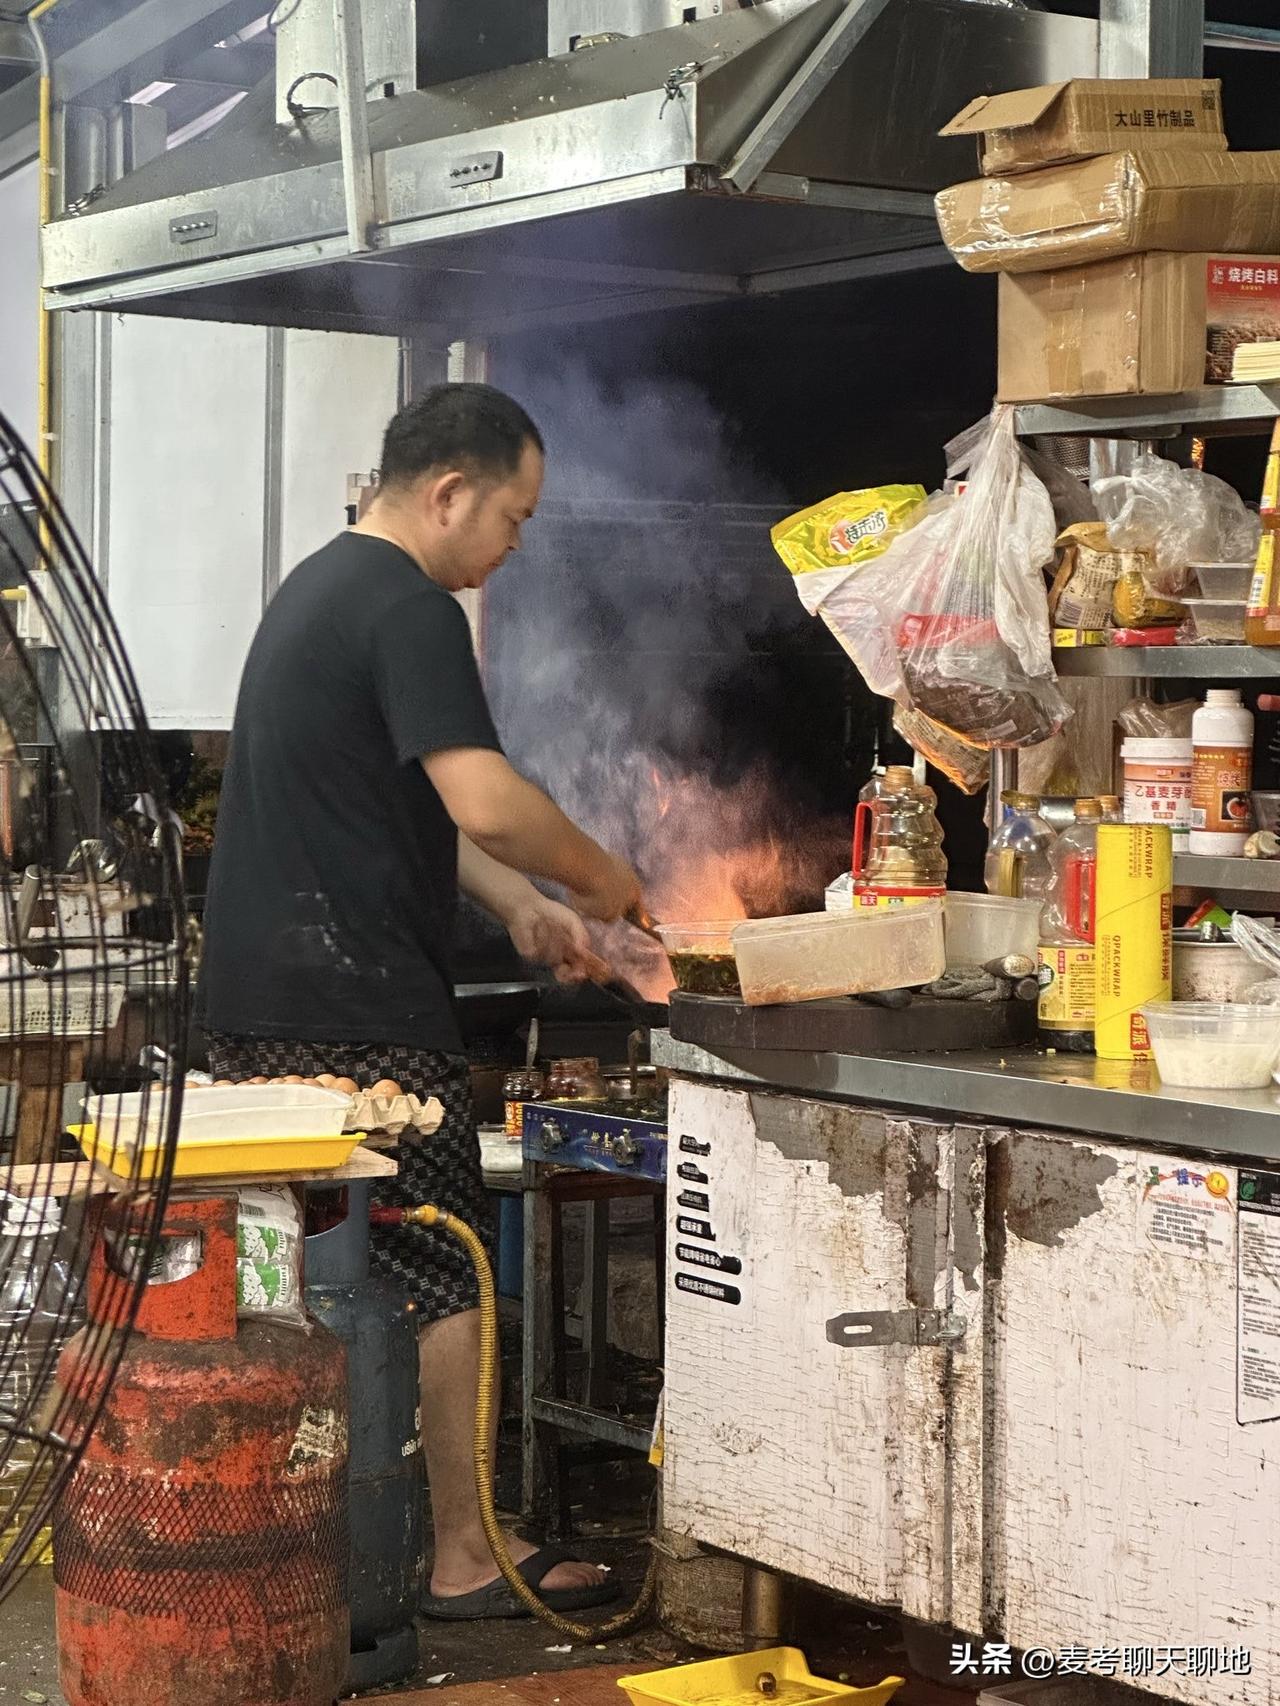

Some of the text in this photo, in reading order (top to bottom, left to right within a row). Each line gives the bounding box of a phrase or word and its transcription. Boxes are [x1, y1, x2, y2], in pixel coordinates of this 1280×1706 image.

[1114, 109, 1195, 128] 大山里竹制品
[1228, 267, 1279, 284] 烧烤白料
[1112, 934, 1122, 998] QPACKWRAP
